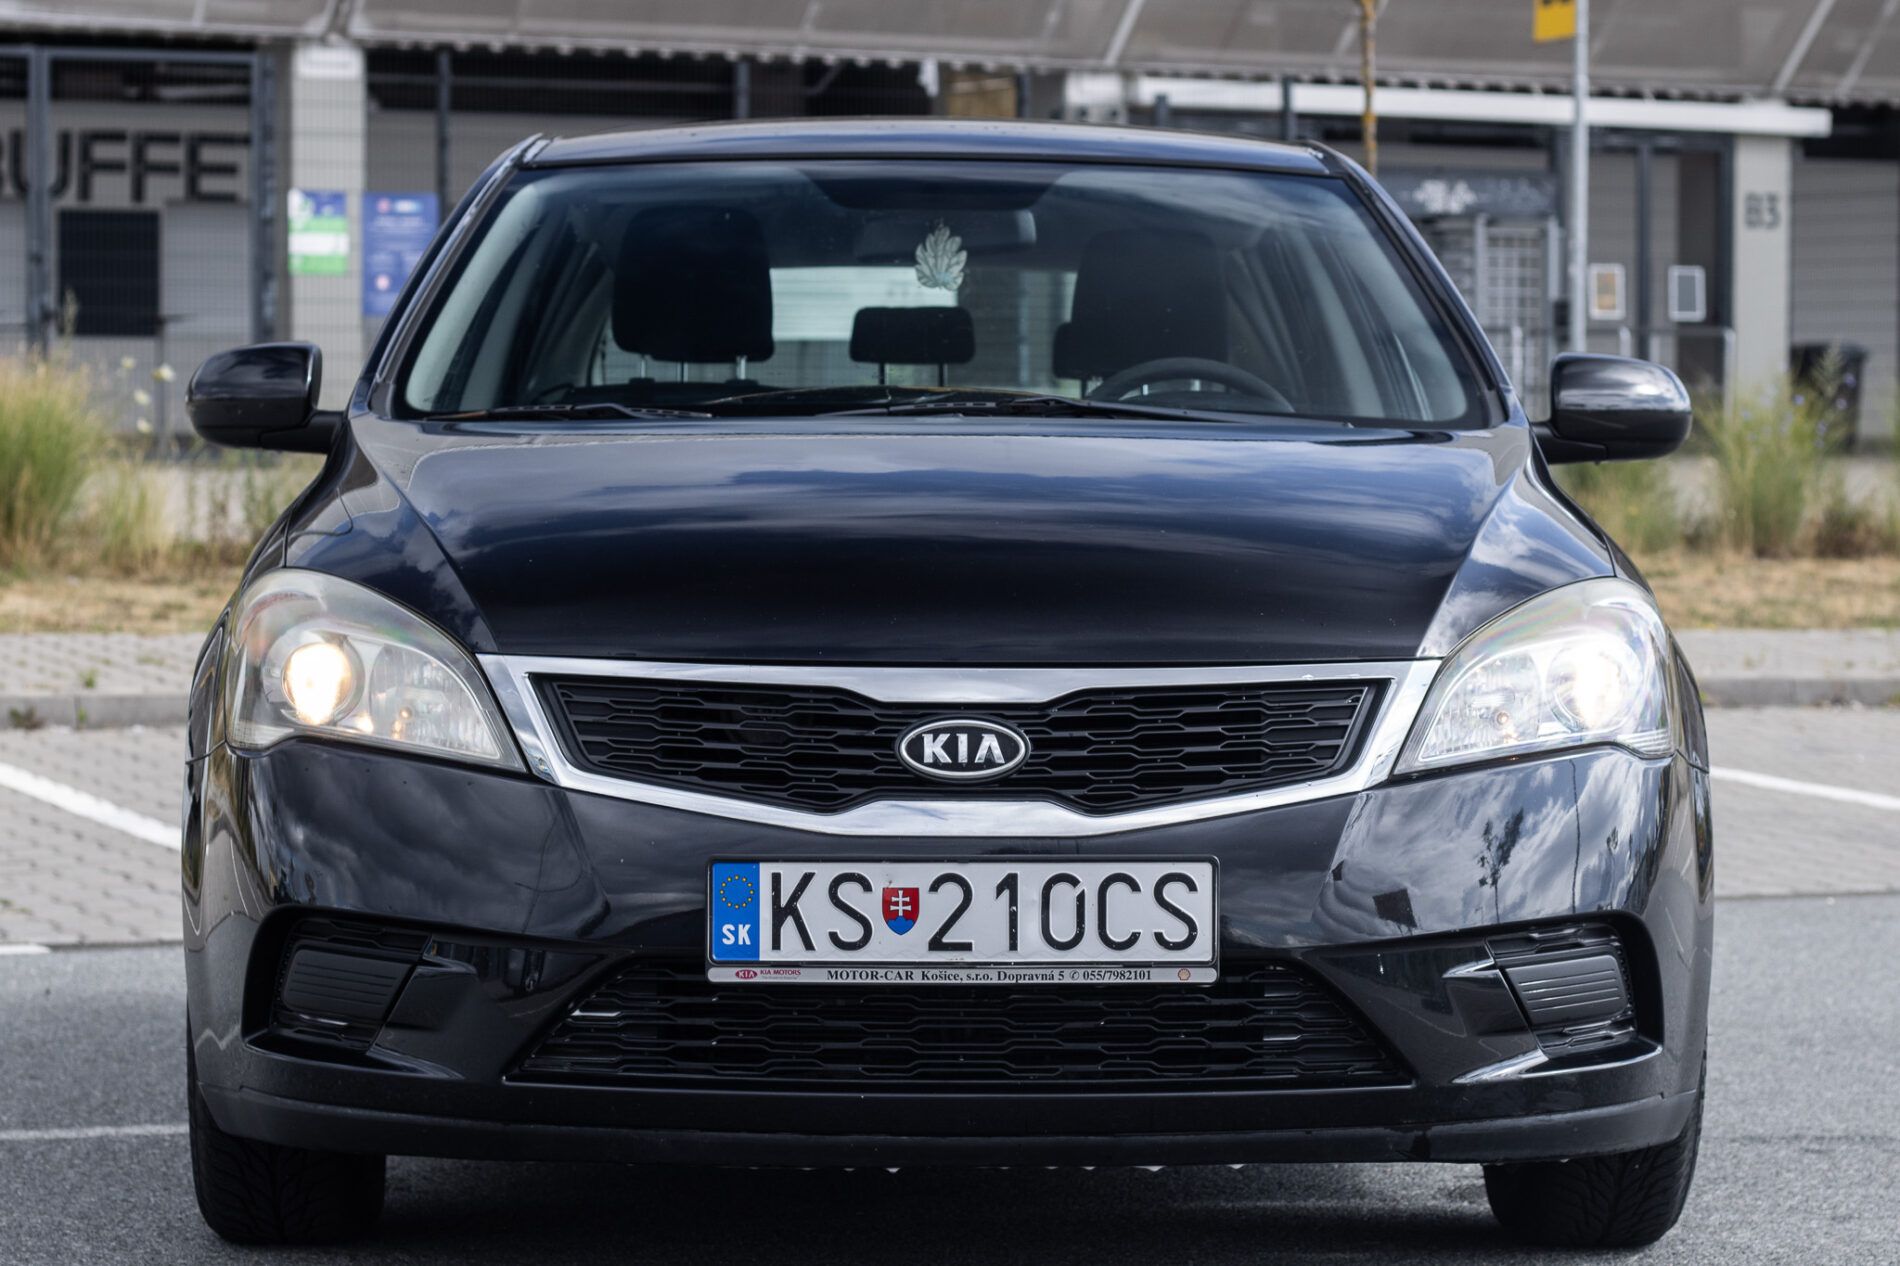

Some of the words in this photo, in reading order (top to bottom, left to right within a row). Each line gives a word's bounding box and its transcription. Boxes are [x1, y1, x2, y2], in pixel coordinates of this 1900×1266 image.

[0, 128, 253, 202] UFFE
[921, 733, 1006, 764] KIA
[771, 872, 874, 951] KS
[928, 872, 1199, 951] 210CS
[721, 923, 752, 946] SK
[738, 970, 757, 979] KIA
[827, 970, 915, 981] MOTOR-CAR
[921, 970, 963, 983] Košice,
[966, 973, 994, 981] s.r.o.
[997, 970, 1055, 983] Dopravná
[1057, 970, 1065, 981] 5
[1082, 970, 1151, 981] 055/7982101
